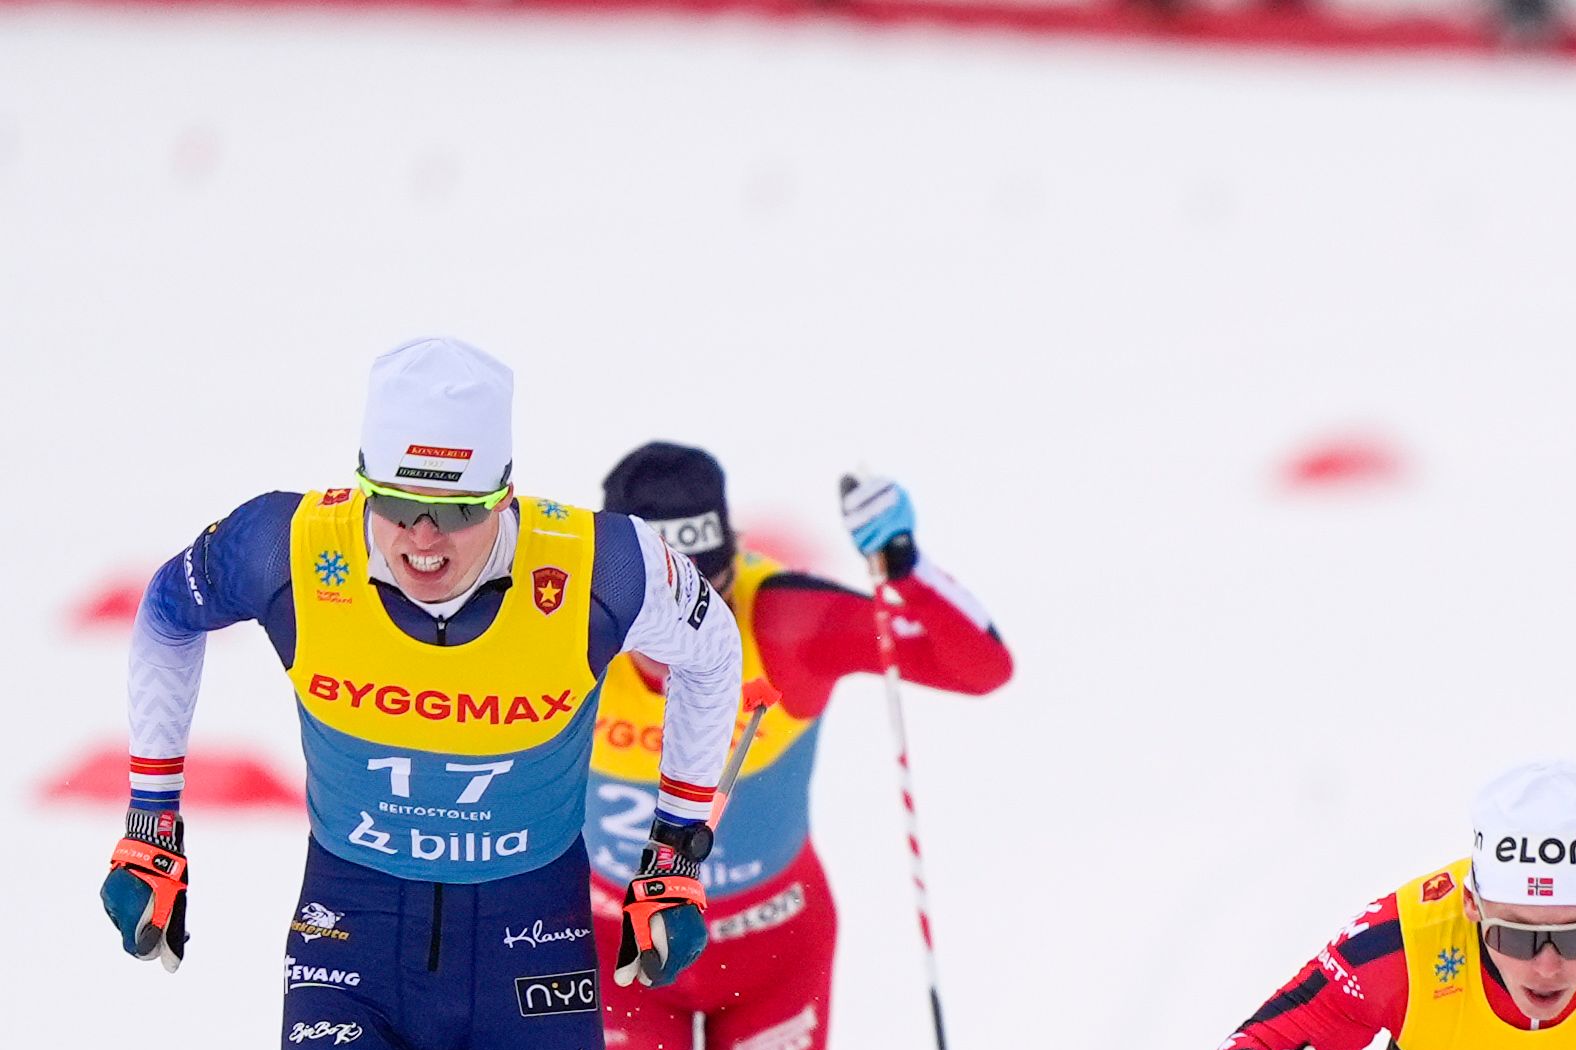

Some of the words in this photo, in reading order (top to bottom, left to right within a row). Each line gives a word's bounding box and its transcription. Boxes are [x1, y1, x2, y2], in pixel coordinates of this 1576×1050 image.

[308, 673, 573, 725] BYGGMAX
[366, 756, 515, 804] 17
[410, 828, 529, 863] bilia
